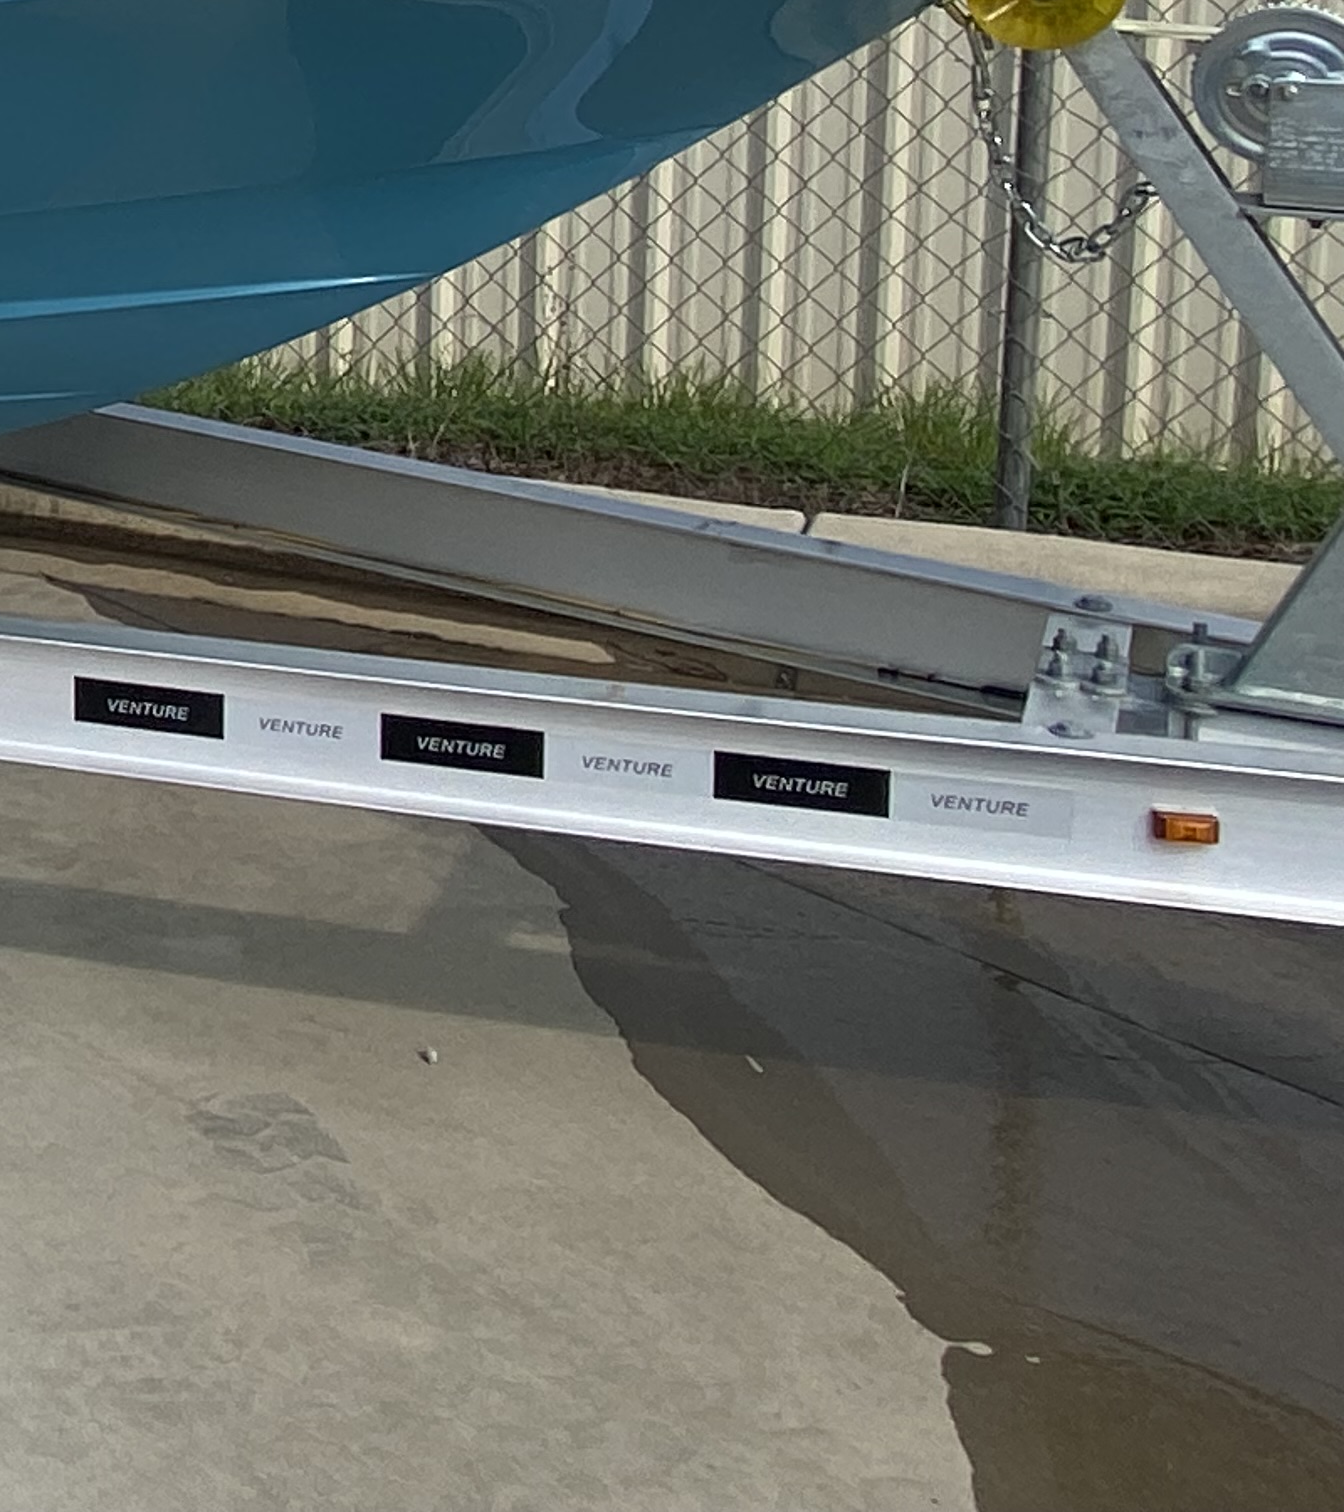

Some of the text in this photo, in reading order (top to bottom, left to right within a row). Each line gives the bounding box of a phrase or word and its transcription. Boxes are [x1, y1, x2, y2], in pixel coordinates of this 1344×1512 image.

[106, 698, 1030, 817] VENTURE VENTURE VENTURE VENTURE VENTURE VENTURE
